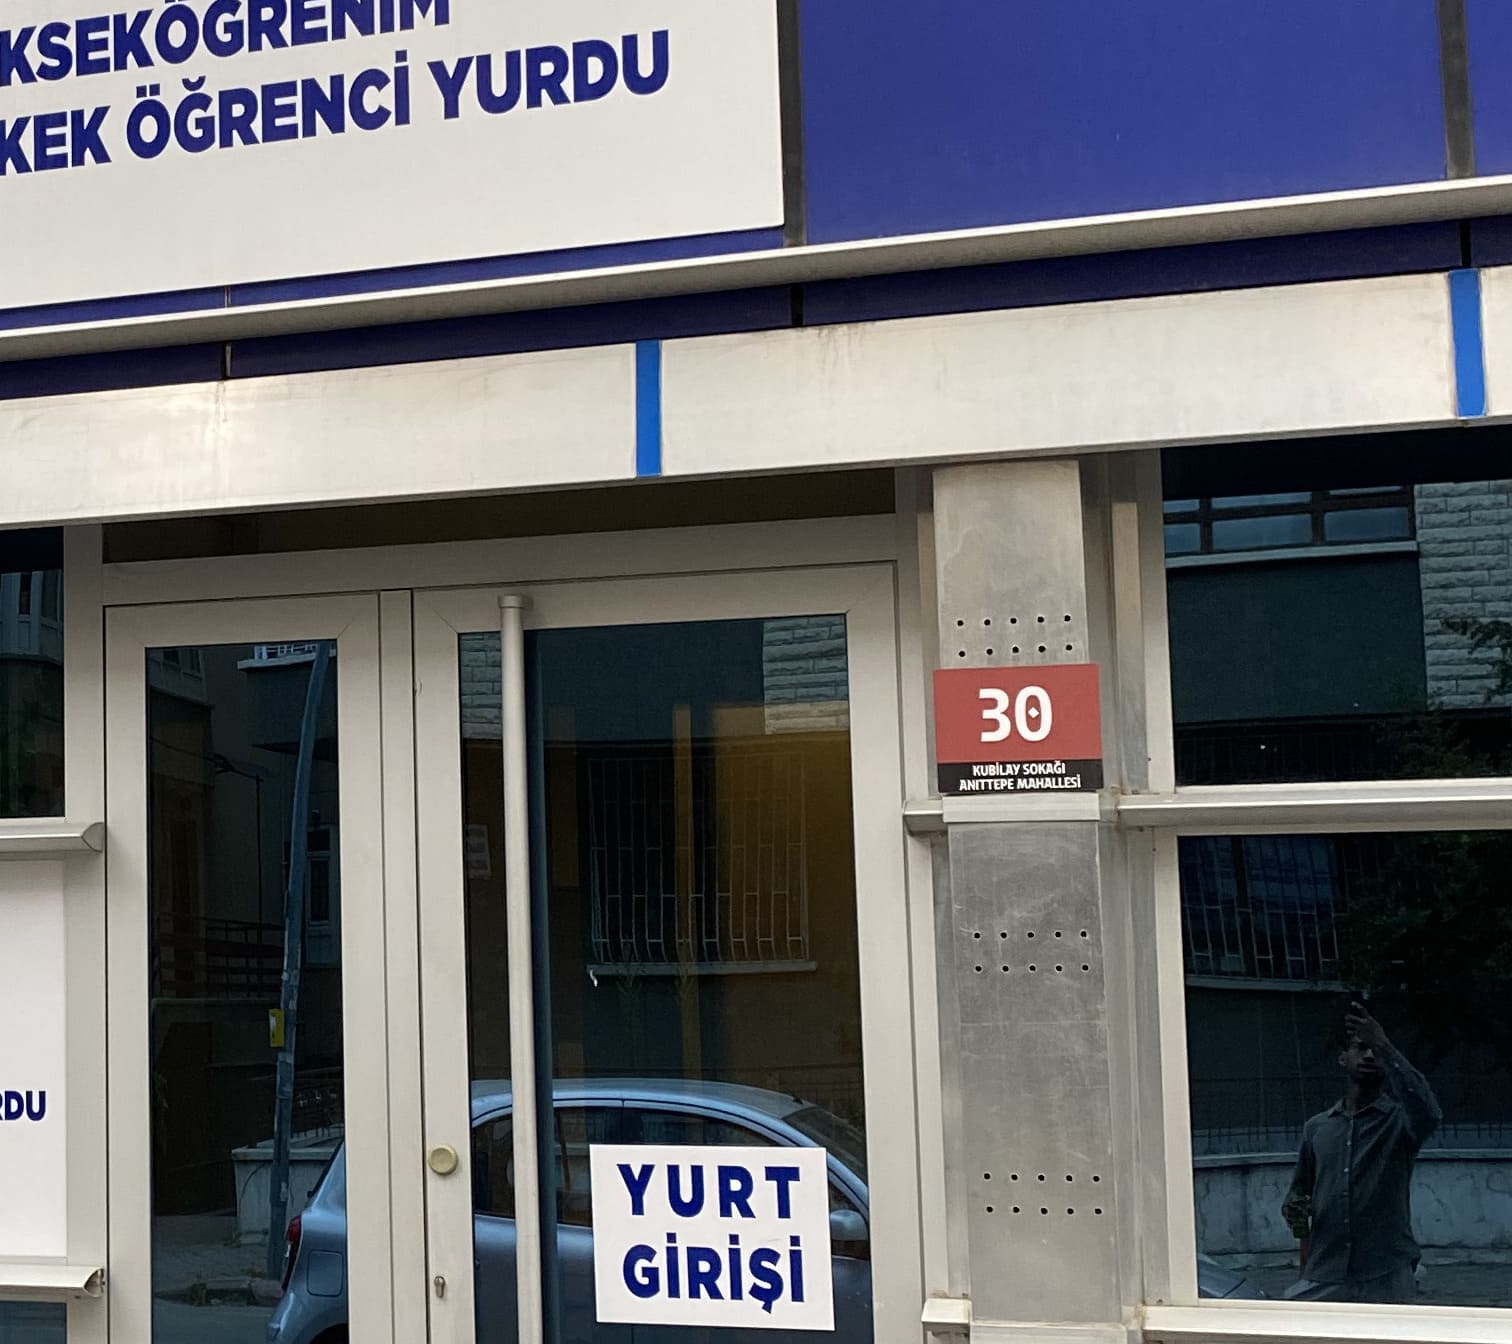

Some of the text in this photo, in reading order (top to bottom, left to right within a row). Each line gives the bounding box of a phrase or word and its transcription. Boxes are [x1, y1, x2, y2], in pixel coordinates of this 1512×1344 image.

[126, 49, 412, 159] ÖĞRENCİ
[425, 29, 670, 120] YURDU
[978, 685, 1053, 743] 30
[959, 773, 1082, 792] ANITTEPE MAHALLESİ
[972, 760, 1066, 777] KUBİLAY SOKAĞI
[616, 1163, 801, 1219] YURT
[622, 1232, 805, 1314] GİRİŞİ
